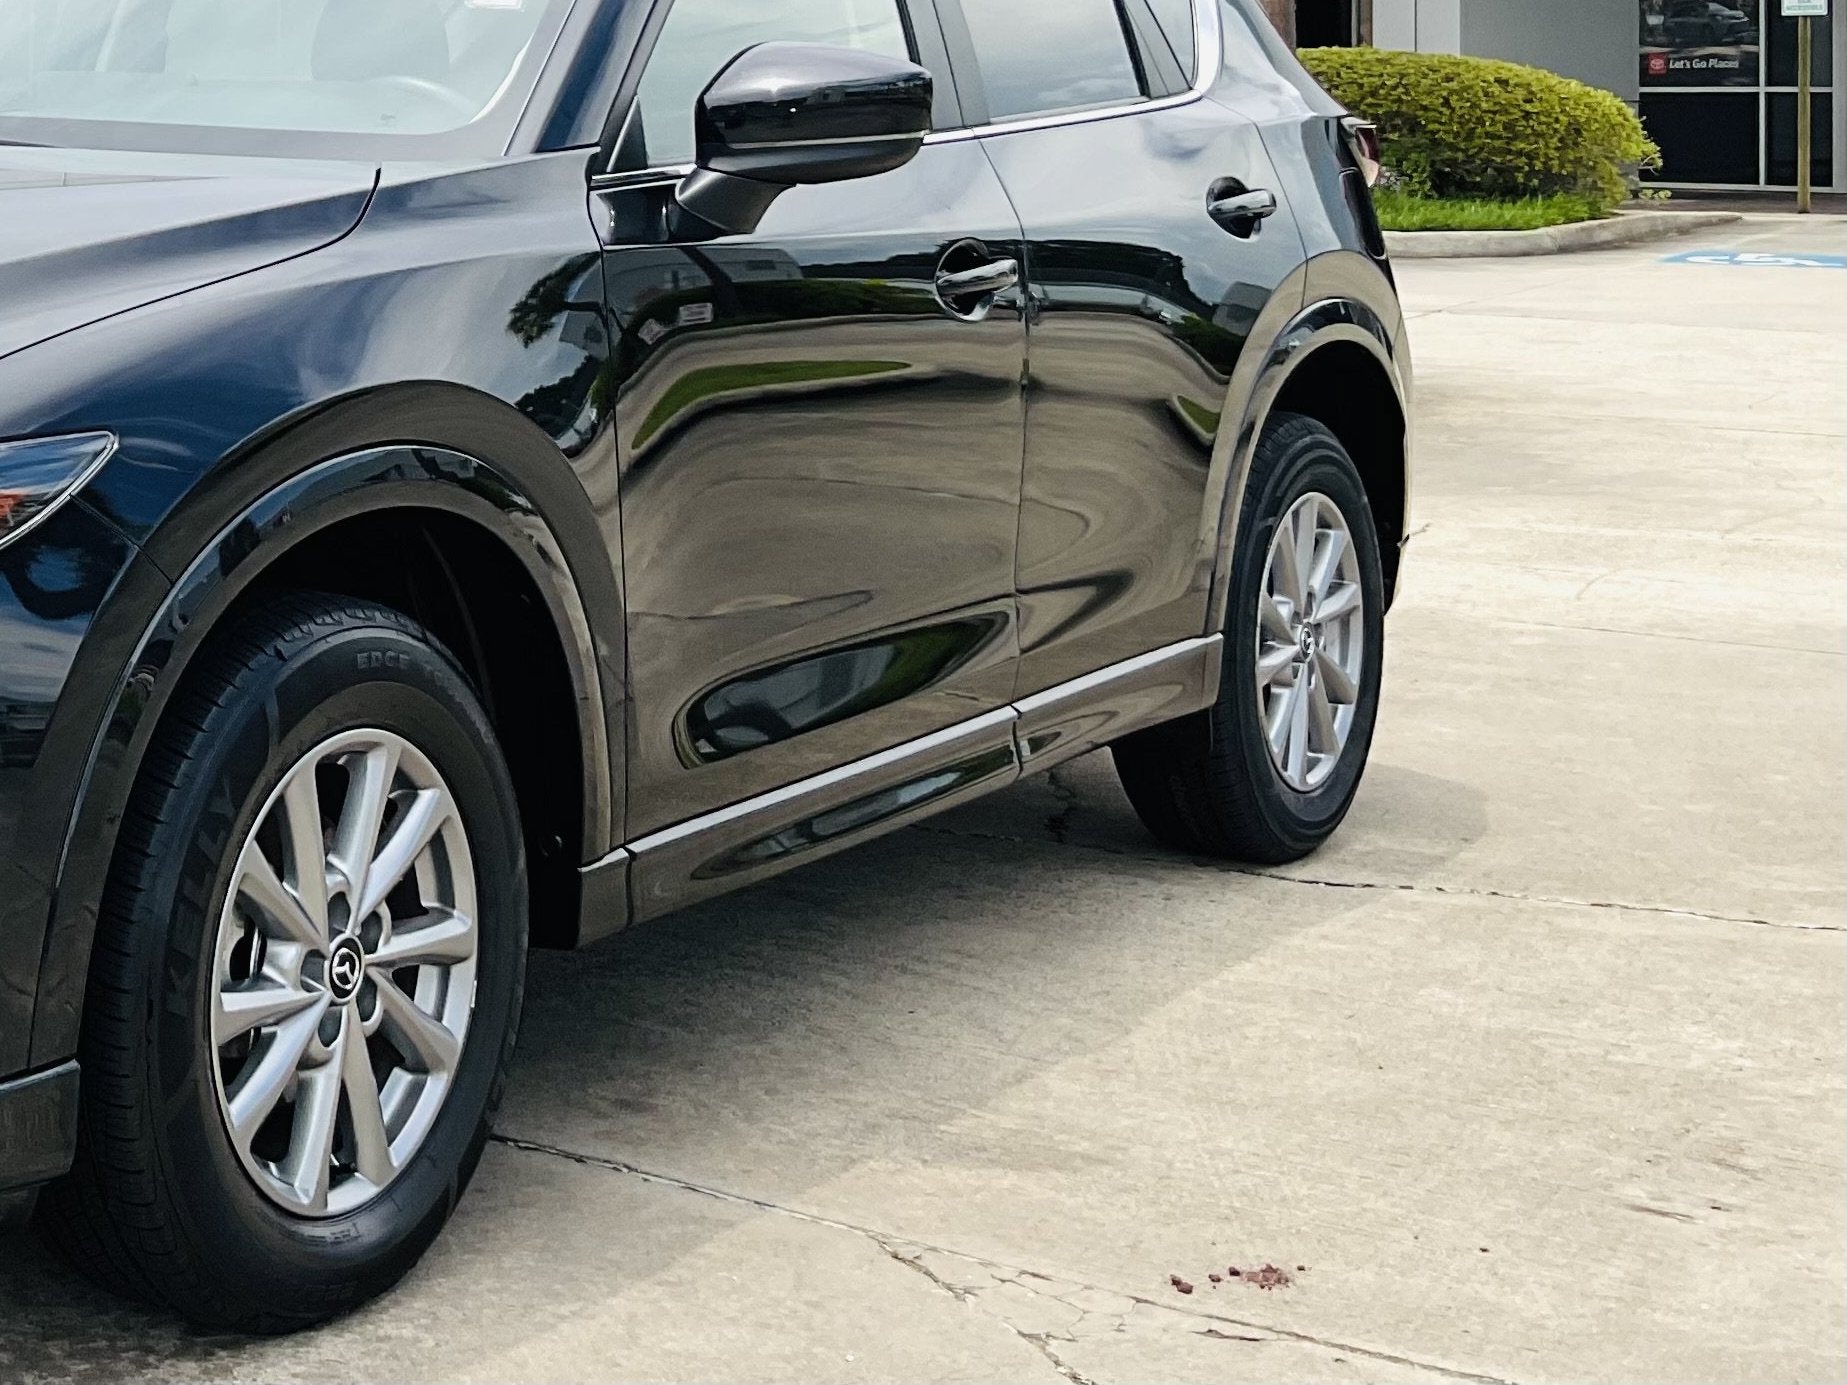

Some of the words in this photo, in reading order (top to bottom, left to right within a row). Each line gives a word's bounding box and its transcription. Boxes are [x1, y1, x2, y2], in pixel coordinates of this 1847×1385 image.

[1669, 59, 1690, 68] Let's
[1692, 58, 1707, 68] Go
[1708, 58, 1739, 68] Places
